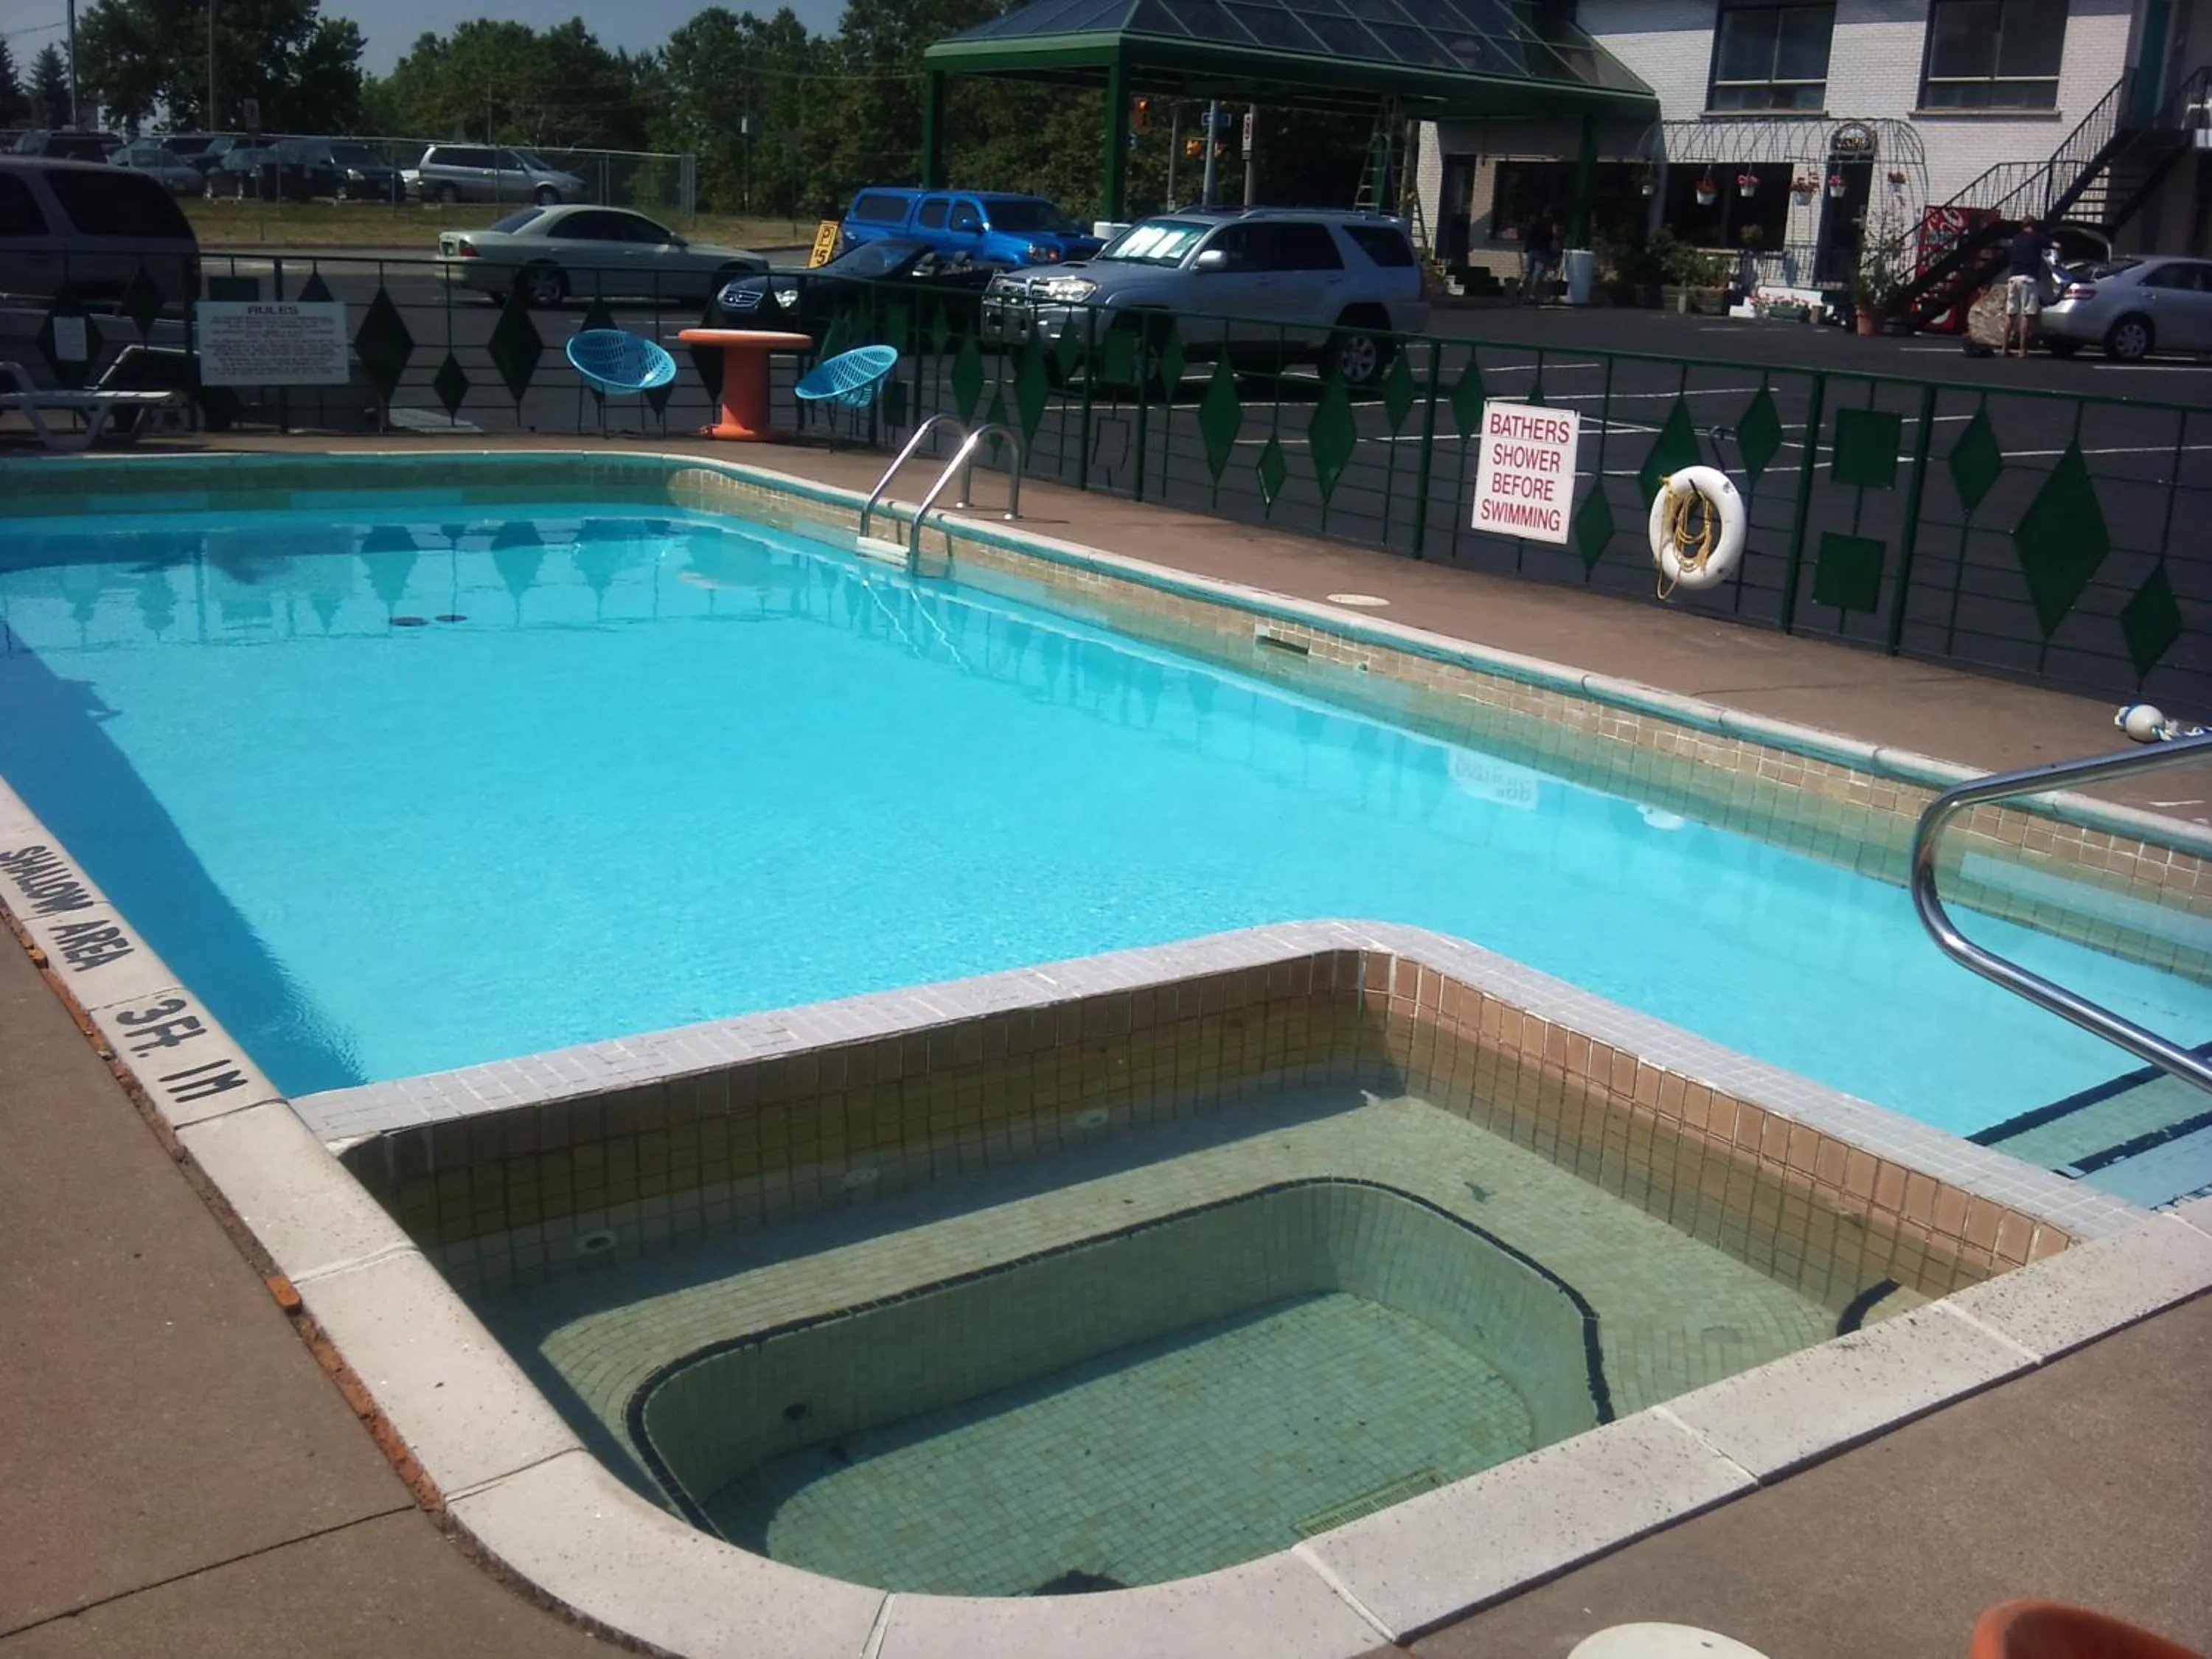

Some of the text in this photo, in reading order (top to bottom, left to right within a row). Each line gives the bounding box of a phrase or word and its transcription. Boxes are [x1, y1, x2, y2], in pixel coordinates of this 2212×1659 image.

[248, 306, 299, 315] RULES
[1489, 413, 1571, 443] BATHERS
[1492, 443, 1561, 473] SHOWER
[1492, 473, 1555, 501] BEFORE
[1481, 499, 1562, 532] SWIMMING
[0, 846, 135, 972] SHALLOW AREA
